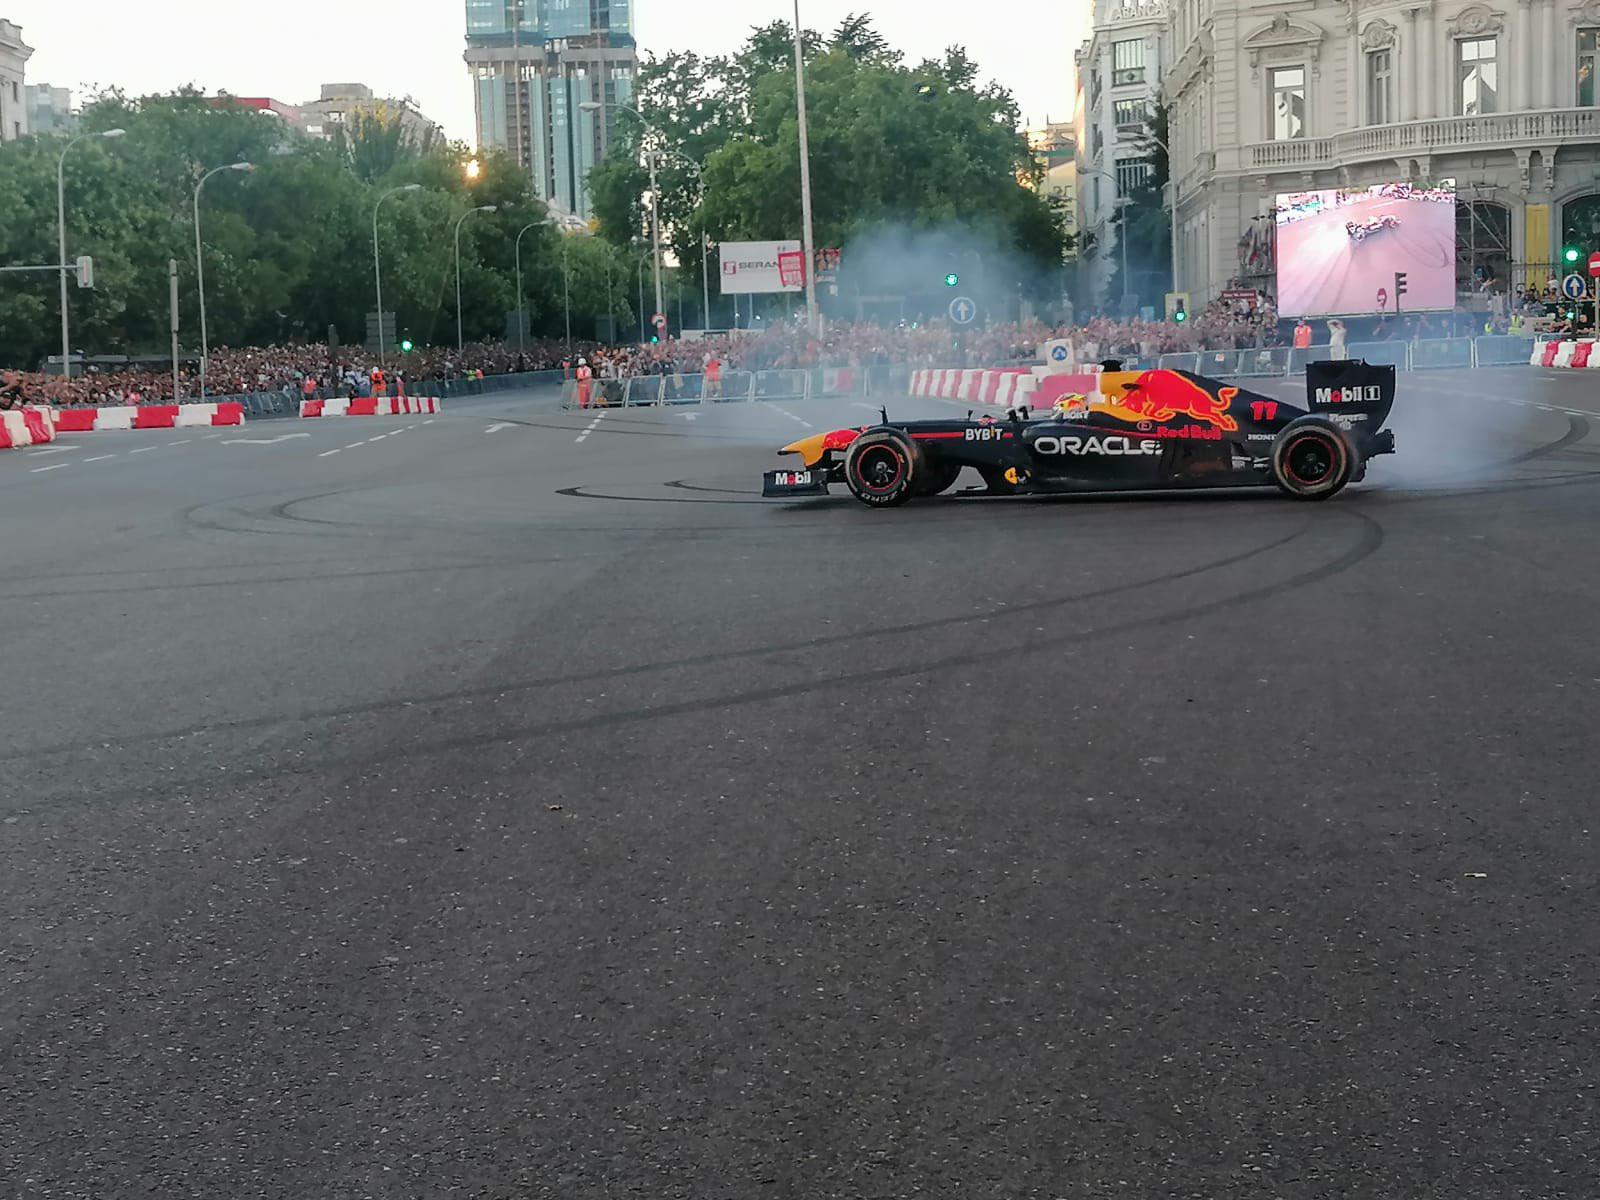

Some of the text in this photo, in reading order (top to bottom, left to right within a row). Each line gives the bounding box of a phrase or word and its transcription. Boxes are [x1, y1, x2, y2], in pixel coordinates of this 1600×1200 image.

[1315, 386, 1380, 403] Mobil 1
[1250, 401, 1278, 420] 11
[965, 425, 1003, 441] BYBIT
[1156, 425, 1222, 440] Red Bull
[1034, 436, 1163, 455] ORACLE
[775, 471, 812, 487] Mobil
